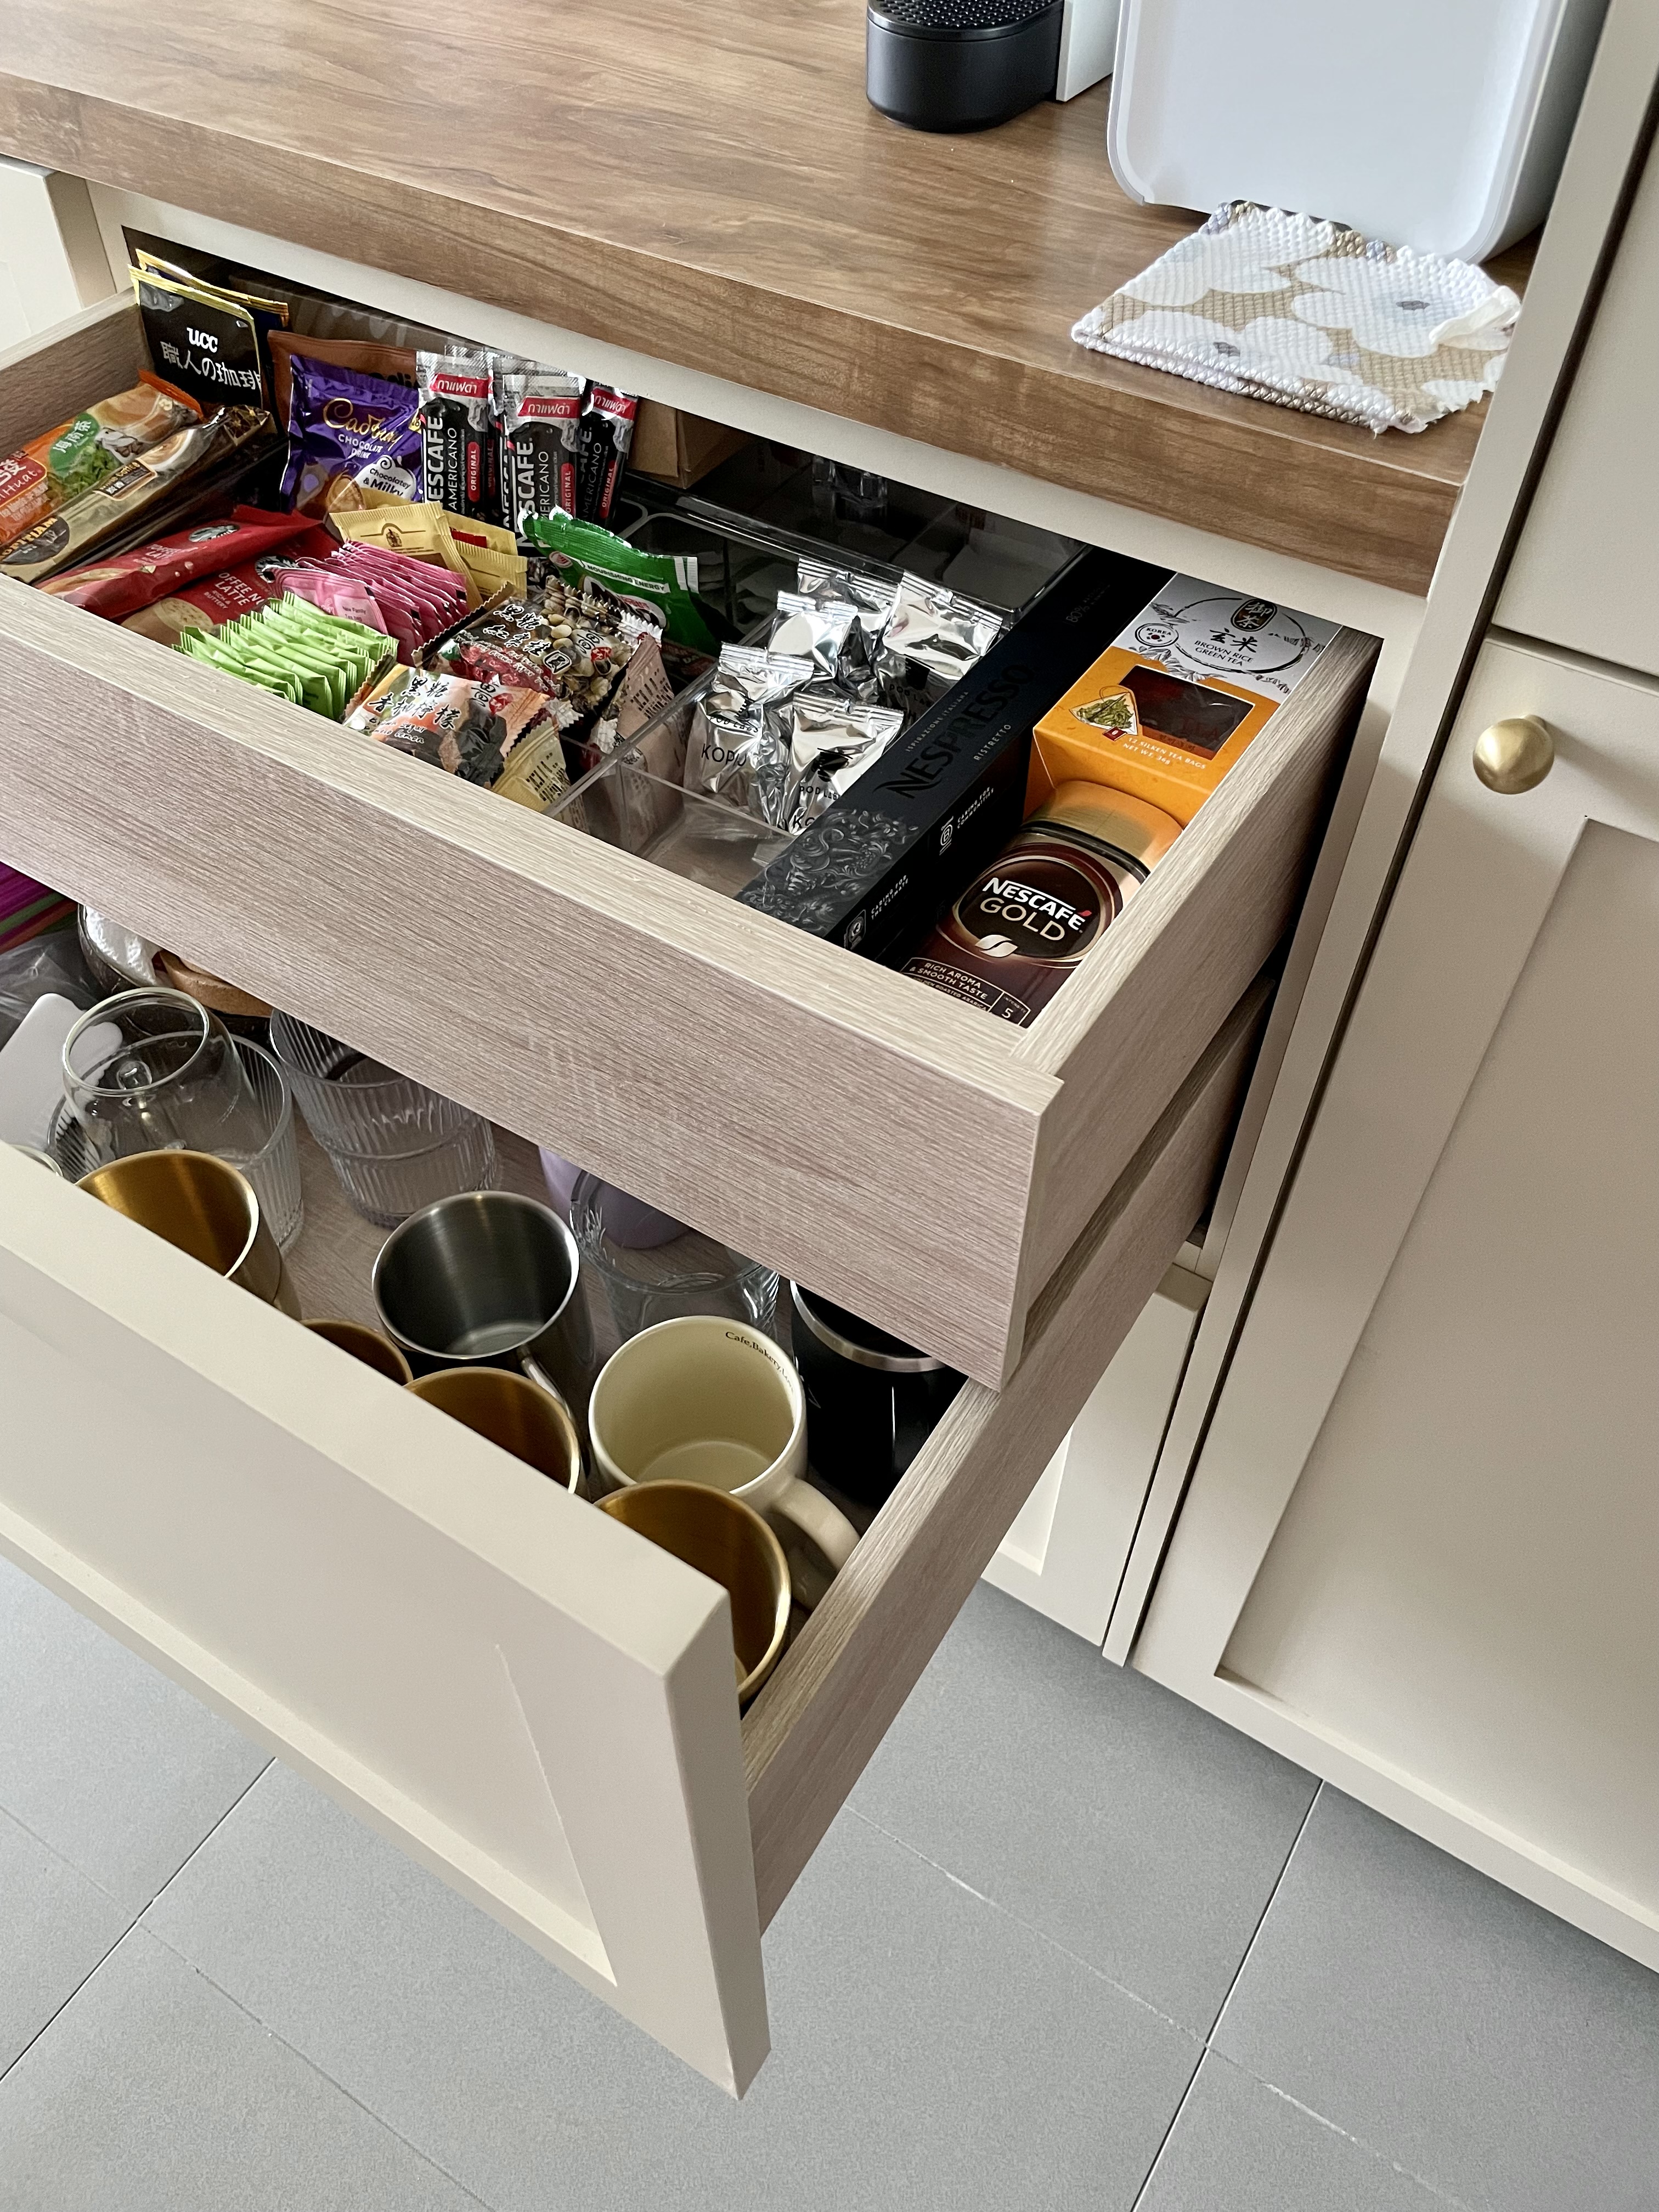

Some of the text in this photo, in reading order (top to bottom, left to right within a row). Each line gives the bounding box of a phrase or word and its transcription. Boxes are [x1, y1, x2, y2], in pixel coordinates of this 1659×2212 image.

[437, 378, 478, 394] กาแฟดำ
[528, 403, 571, 415] กาแฟดำ
[323, 398, 404, 452] Cadbury
[338, 433, 383, 453] CHOCOLATE
[363, 477, 370, 486] &
[369, 467, 411, 490] Chocolatey
[447, 427, 458, 511] AMERICANO
[538, 450, 550, 519] ERICANO
[601, 467, 614, 508] ORIGINAL
[0, 517, 58, 560] OPITIAM
[218, 572, 253, 595] OFFEE
[587, 565, 665, 591] NOURISHING ENERGY
[214, 581, 251, 606] LATTE
[1235, 601, 1273, 629] 御茶
[1146, 627, 1172, 636] KOREA
[1209, 627, 1258, 653] 玄米
[1194, 640, 1254, 663] BROWN RICE
[1195, 647, 1243, 667] GREEN TEA
[402, 675, 450, 698] 黑糖
[400, 721, 428, 733] sugar
[872, 664, 1035, 799] NESPRESSO
[905, 691, 969, 753] ISPIRAZIONE ITALIANA
[973, 724, 1012, 761] RISTRETTO
[1123, 743, 1138, 752] NET
[1139, 741, 1167, 754] SILKEN
[1169, 752, 1182, 761] TEA
[1184, 758, 1206, 769] BAGS
[799, 785, 840, 801] POD LAB
[957, 786, 990, 823] CARING FOR
[957, 787, 994, 829] COMMUNITIES
[871, 874, 907, 914] CARING FOR
[884, 878, 909, 906] CLIMATE
[980, 897, 1065, 941] GOLD
[917, 967, 957, 985] SMOOTH
[958, 981, 989, 1000] TASTE
[924, 962, 981, 989] RICH AROMA
[935, 984, 961, 998] ROASTED
[961, 996, 988, 1012] ARABICA
[1001, 1007, 1014, 1019] 5
